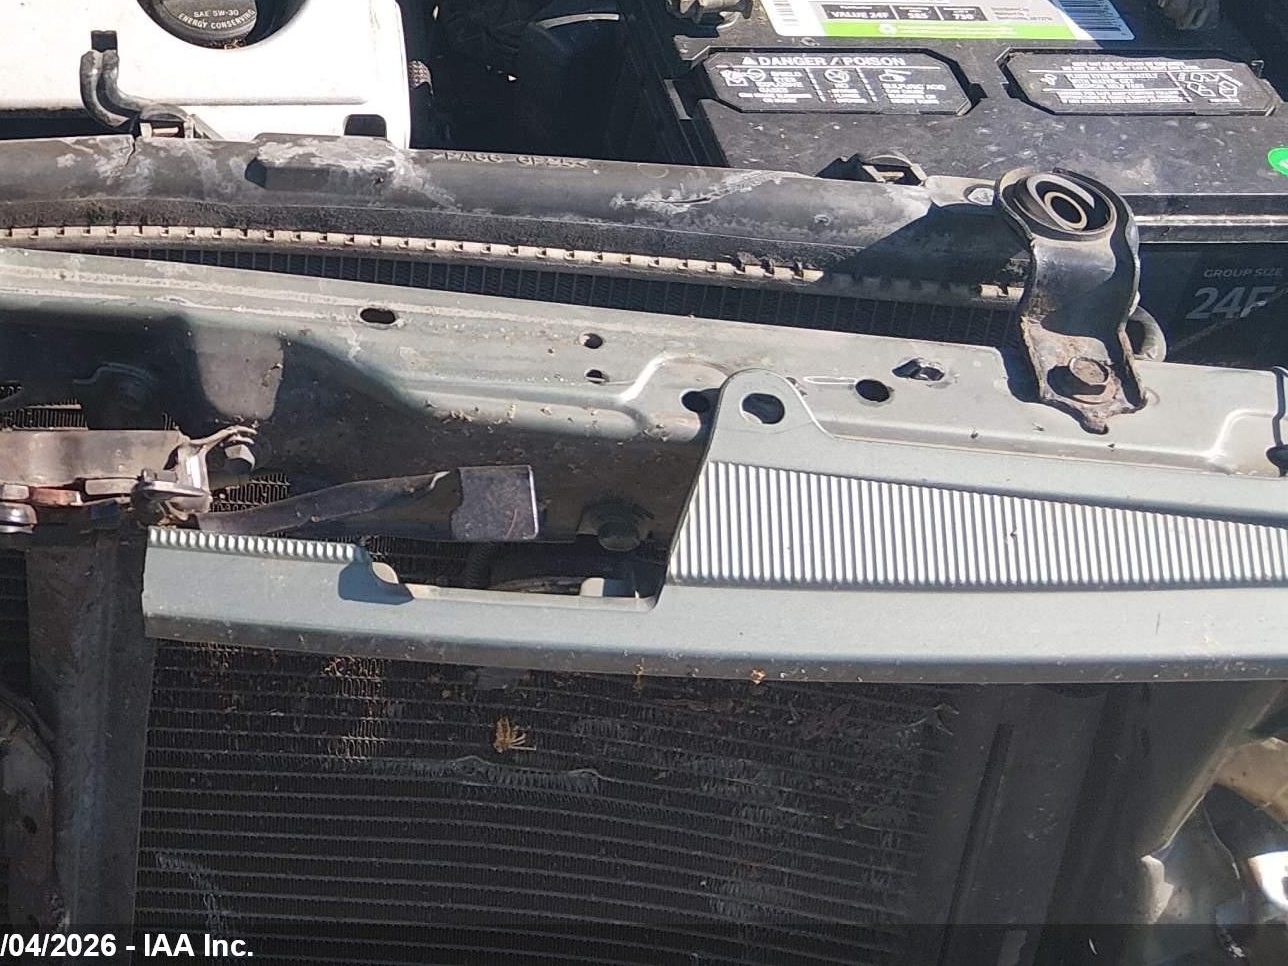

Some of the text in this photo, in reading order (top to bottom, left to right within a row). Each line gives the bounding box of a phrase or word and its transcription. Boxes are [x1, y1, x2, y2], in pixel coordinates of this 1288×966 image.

[178, 9, 256, 29] ENERGY CONSERVING
[193, 9, 240, 18] SAE 5W-30
[757, 56, 827, 66] DANGER
[841, 57, 906, 66] POISON
[1203, 267, 1285, 278] GROUP SIZE
[1185, 286, 1277, 320] 24F
